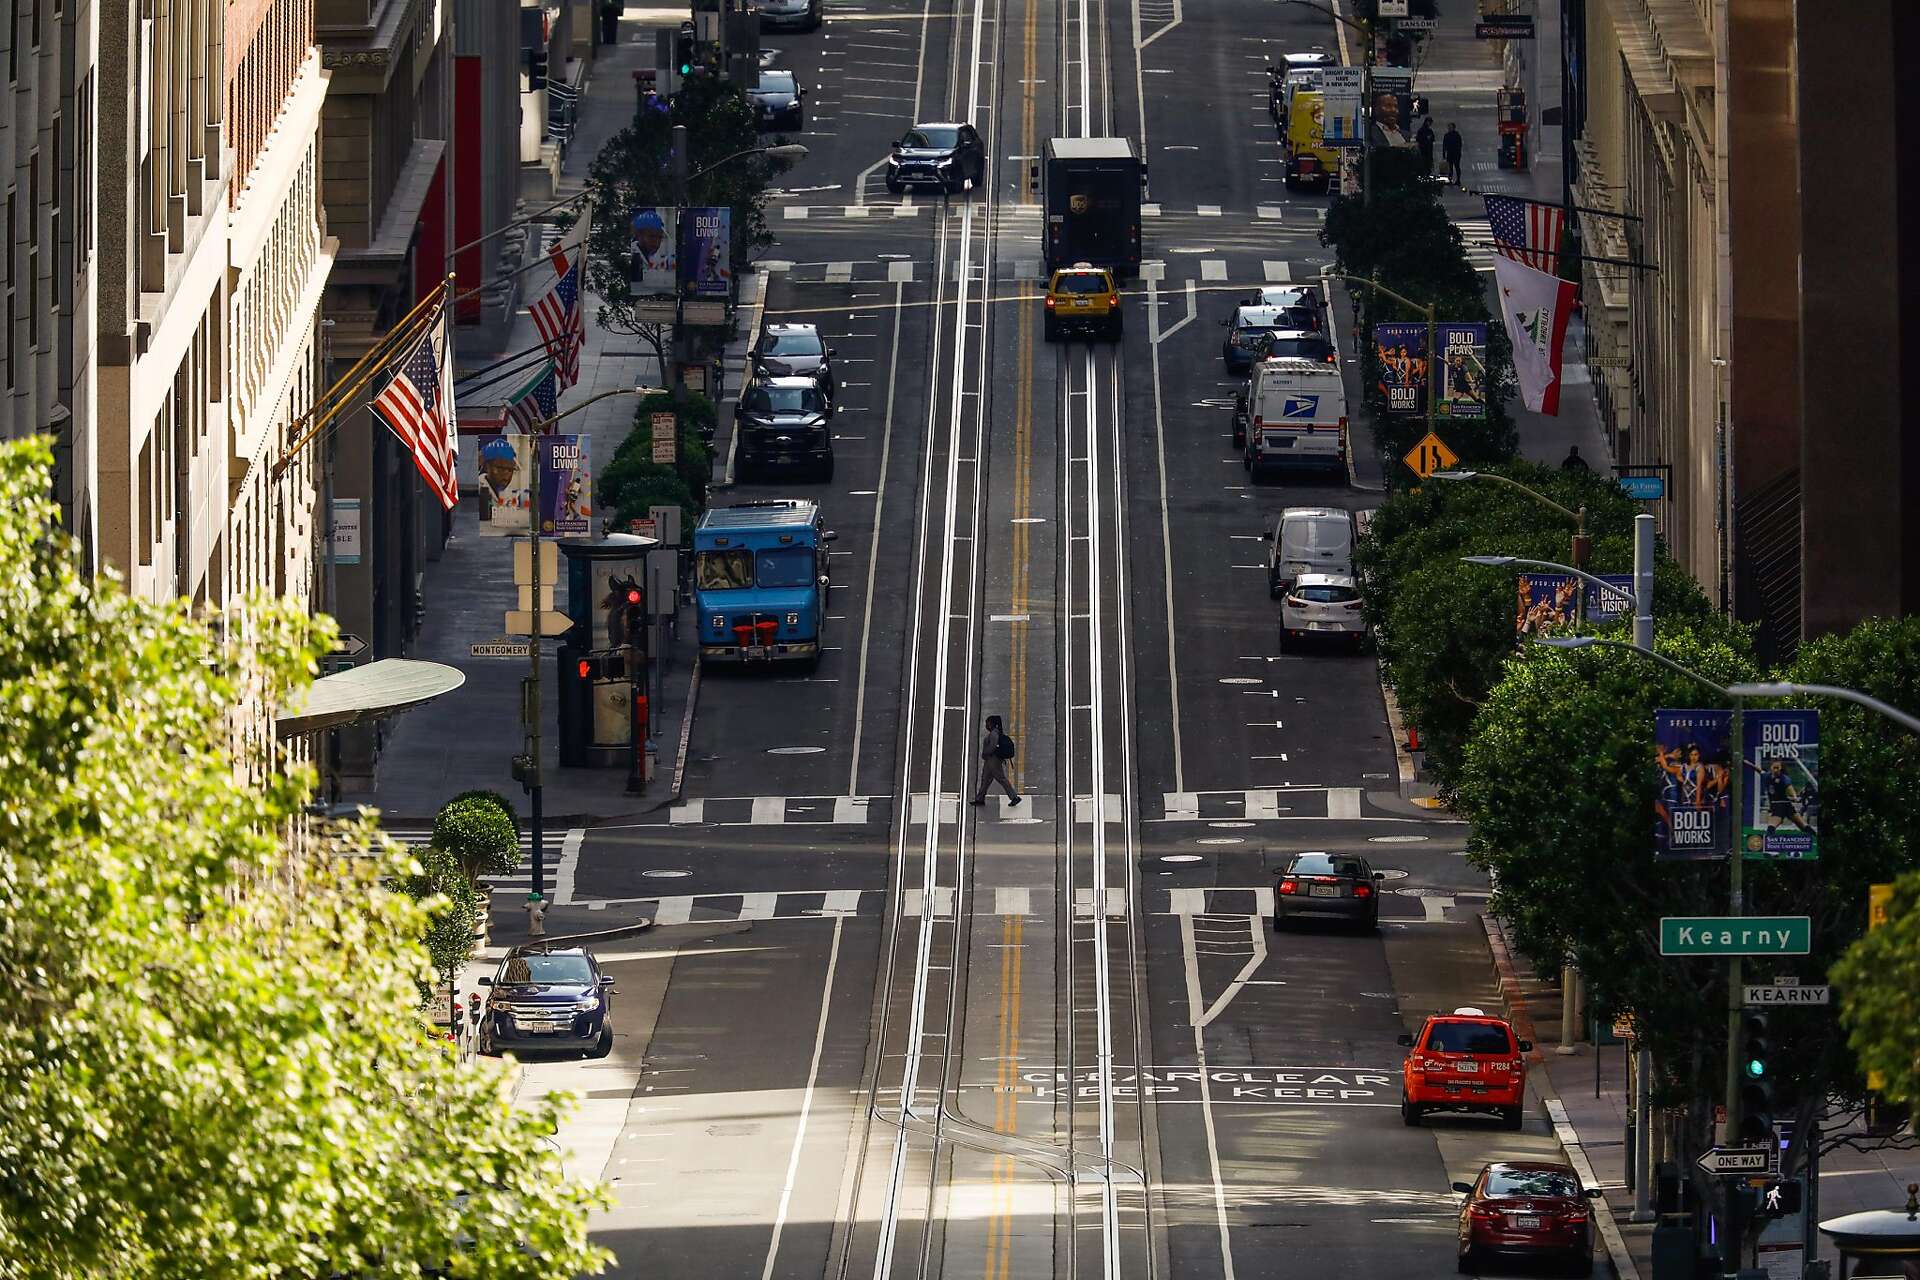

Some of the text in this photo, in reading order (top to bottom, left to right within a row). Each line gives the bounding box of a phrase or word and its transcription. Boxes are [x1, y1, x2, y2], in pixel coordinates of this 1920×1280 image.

[696, 216, 719, 228] BOLD
[696, 229, 719, 237] LIVING
[1449, 332, 1473, 344] BOLD
[1449, 345, 1473, 355] PLAYS
[1391, 388, 1415, 400] BOLD
[1391, 400, 1415, 409] WORKS
[553, 445, 578, 458] BOLD
[553, 459, 578, 469] LIVING
[1601, 601, 1629, 612] VISION
[473, 646, 528, 655] MONTGOMERY
[1762, 724, 1799, 742] BOLD
[1762, 743, 1799, 758] PLAYS
[1674, 812, 1710, 829] BOLD
[1674, 830, 1711, 844] WORKS
[1679, 927, 1791, 948] Kearny
[1750, 989, 1825, 1001] KEARNY
[1491, 1062, 1510, 1071] P1284
[1023, 1072, 1201, 1082] CLEAR
[1211, 1072, 1391, 1086] CLEAR
[1037, 1086, 1179, 1096] KEEP
[1233, 1087, 1375, 1099] KEEP
[1718, 1156, 1762, 1166] ONE WAY
